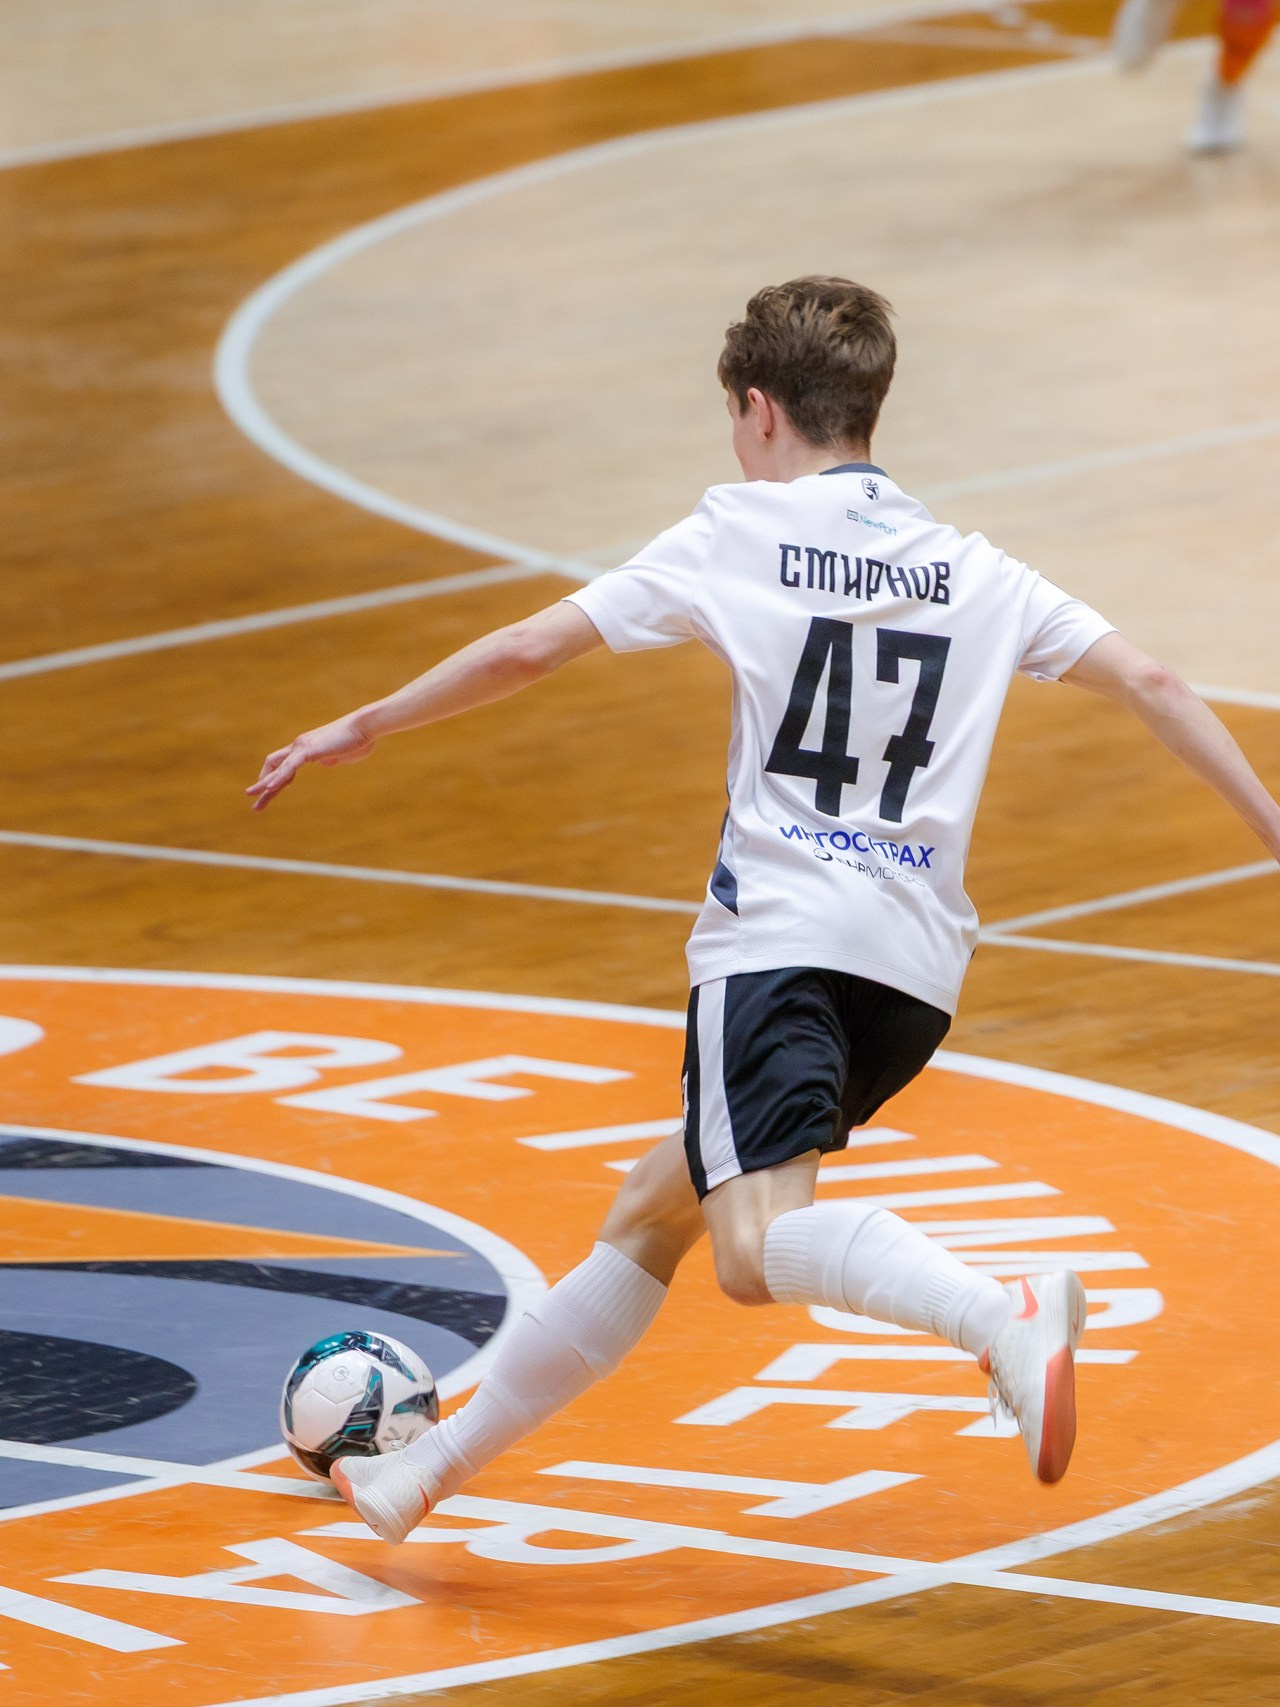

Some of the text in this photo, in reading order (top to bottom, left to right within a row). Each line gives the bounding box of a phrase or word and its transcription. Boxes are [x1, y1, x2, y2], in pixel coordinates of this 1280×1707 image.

[778, 543, 951, 606] СМИРНОВ
[764, 616, 951, 823] 47
[69, 1031, 635, 1122] BE
